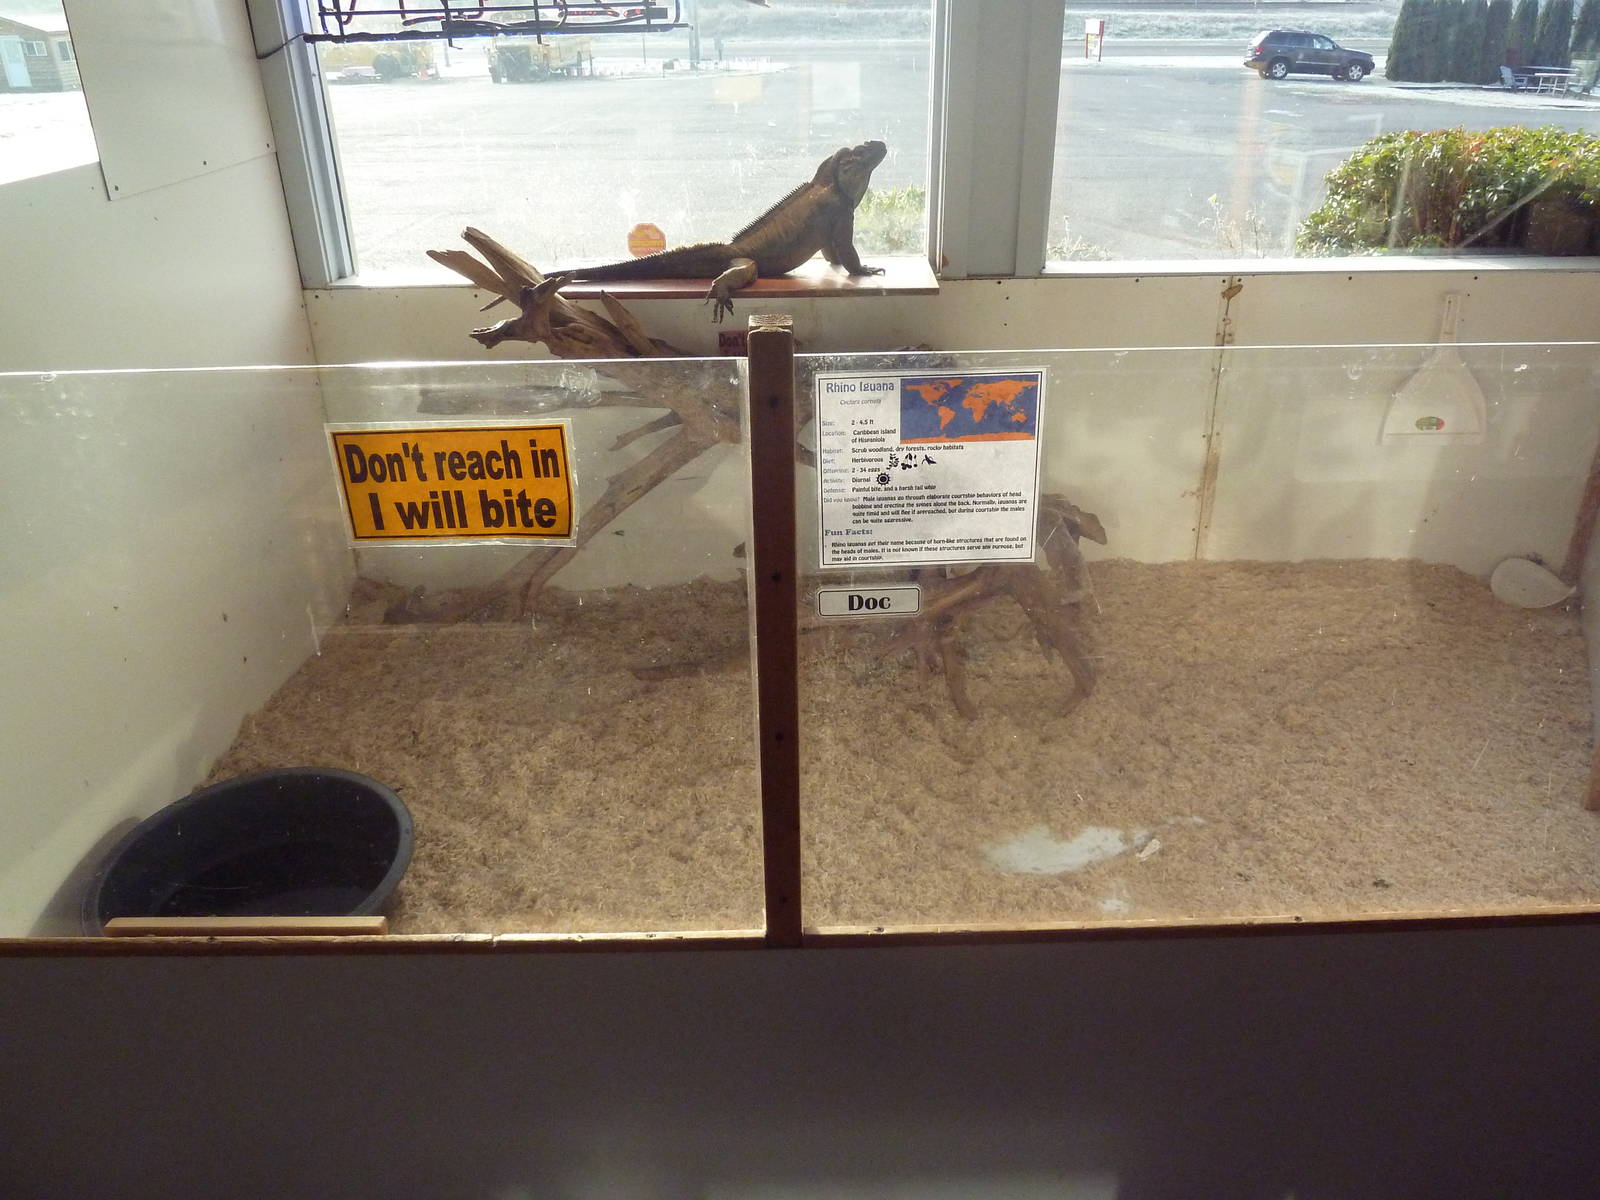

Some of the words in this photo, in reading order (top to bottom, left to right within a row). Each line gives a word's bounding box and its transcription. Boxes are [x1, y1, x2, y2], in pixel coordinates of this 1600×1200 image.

[826, 382, 856, 393] Rhino
[860, 381, 894, 392] Iguana
[343, 442, 427, 483] Don't
[434, 440, 523, 481] reach
[529, 439, 560, 478] in
[368, 492, 384, 531] I
[394, 490, 468, 529] will
[479, 489, 557, 528] bite
[848, 594, 891, 611] Doc
